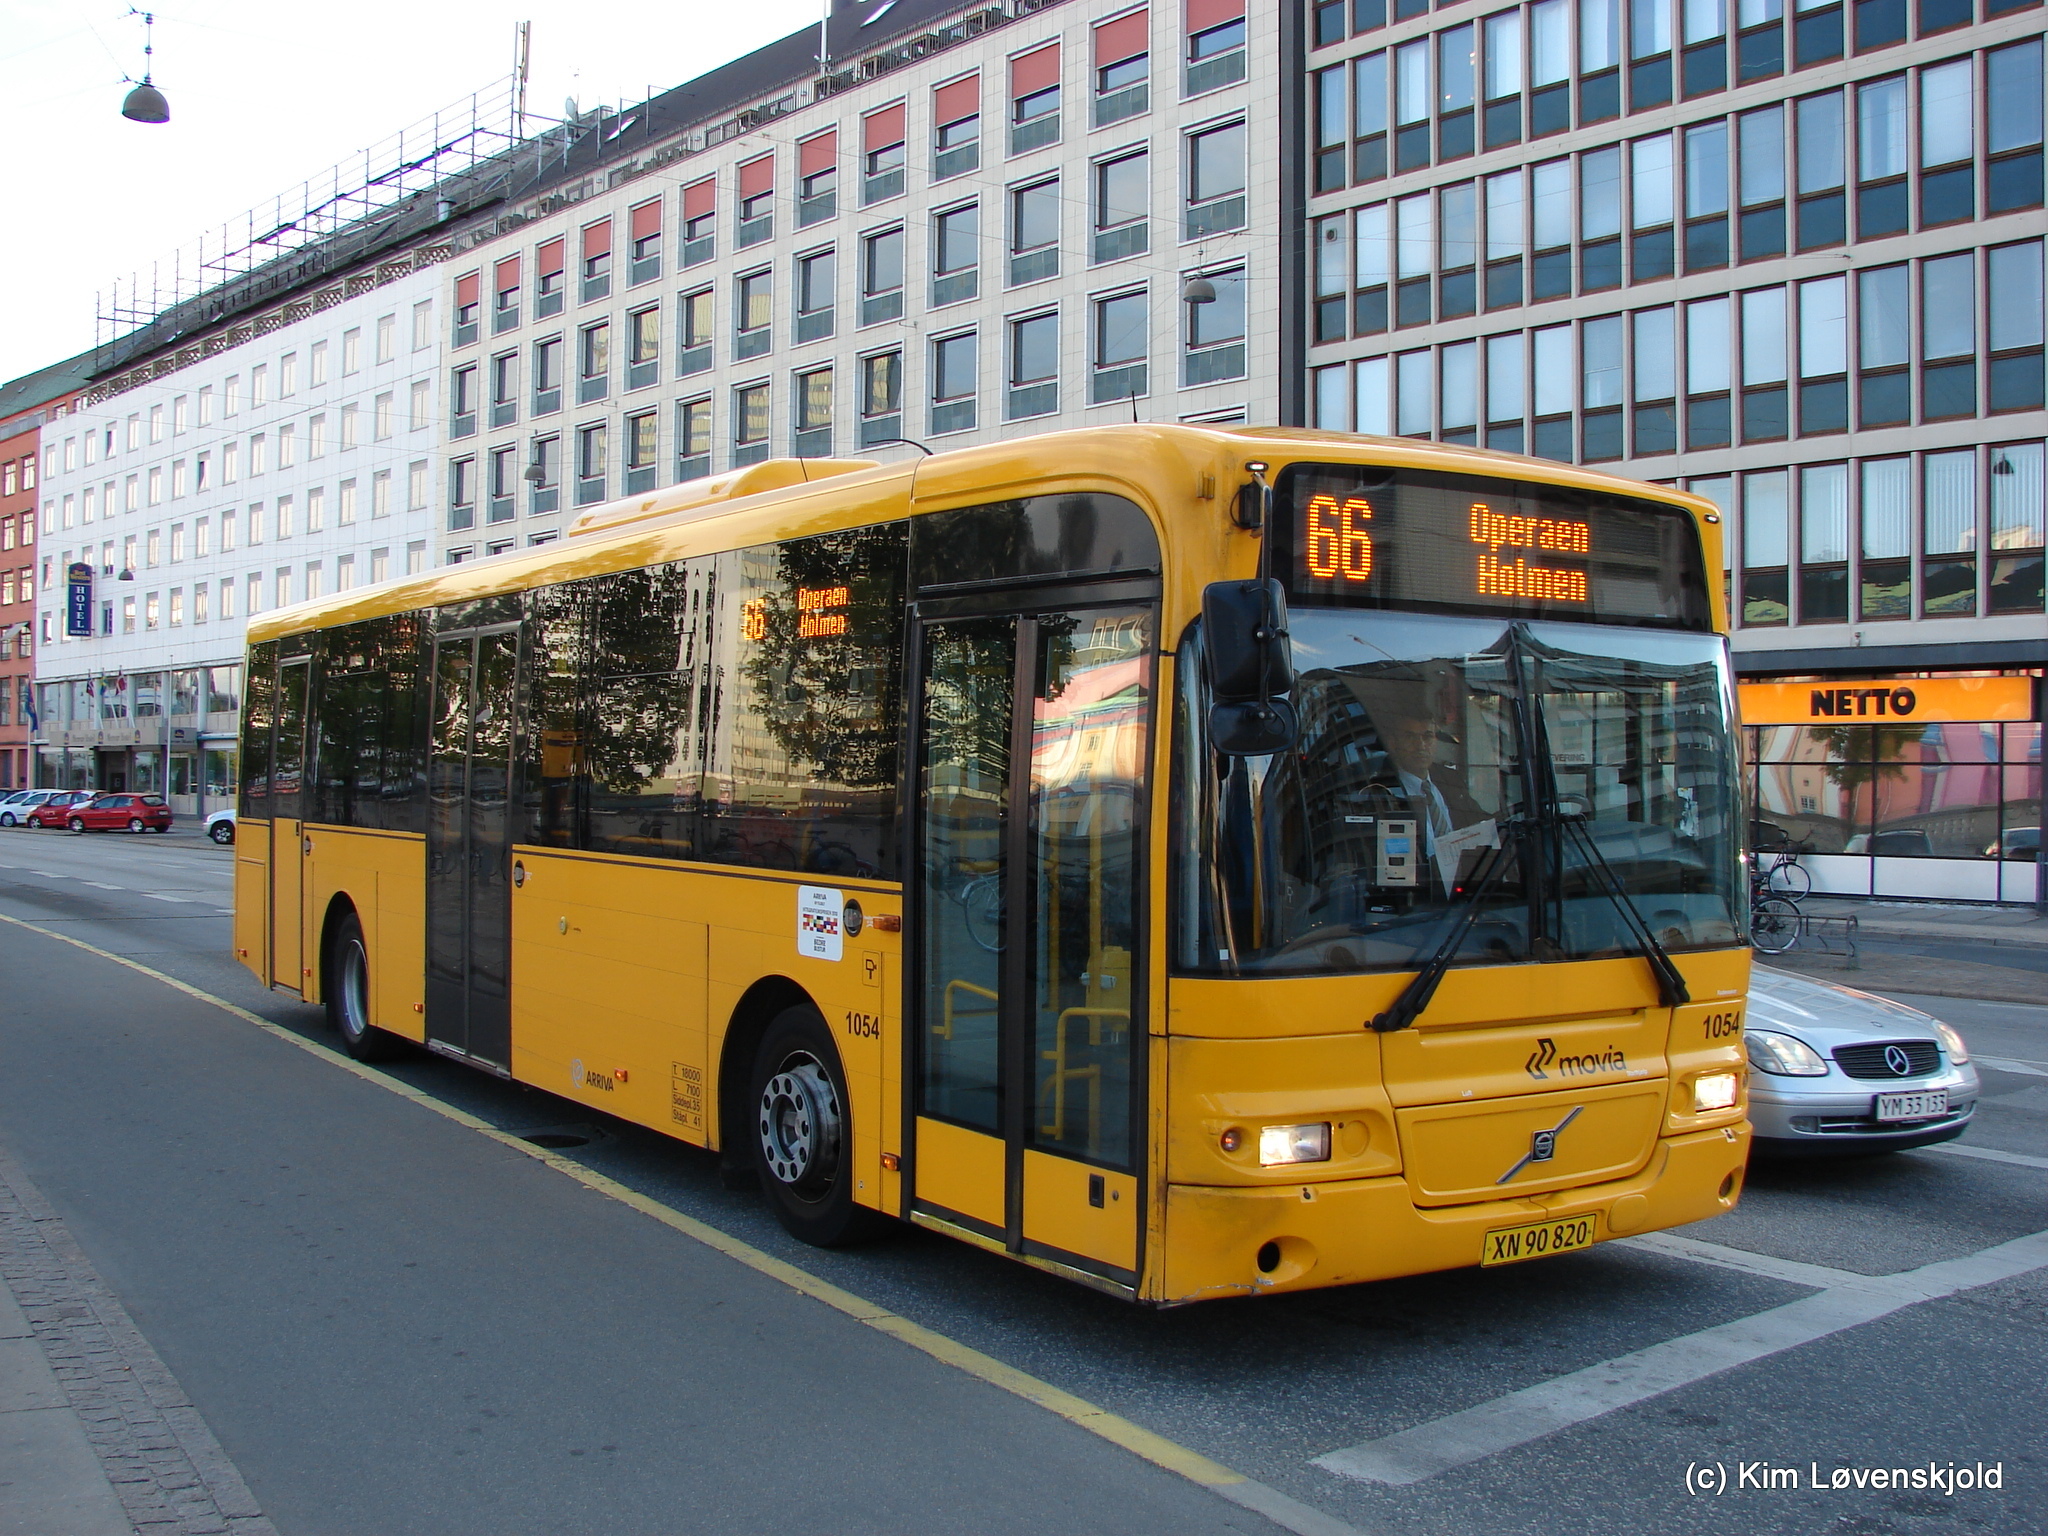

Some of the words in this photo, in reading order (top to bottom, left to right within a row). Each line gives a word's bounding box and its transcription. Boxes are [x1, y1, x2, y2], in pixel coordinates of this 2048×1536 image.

[1308, 495, 1371, 580] 66
[1470, 503, 1589, 552] Operaen
[1479, 554, 1587, 601] Holmen
[76, 586, 85, 628] HOTEL
[743, 598, 765, 640] 66
[799, 587, 847, 613] Operaen
[800, 614, 845, 637] Holmen
[1810, 687, 1916, 716] NETTO
[846, 1011, 879, 1040] 1054
[1703, 1011, 1740, 1040] 1054
[682, 1067, 700, 1082] 18000
[1559, 1045, 1626, 1077] movia
[586, 1070, 614, 1092] ARRIVA
[686, 1083, 700, 1098] 7100
[1881, 1098, 1902, 1116] YM
[1905, 1096, 1921, 1115] 33
[1926, 1094, 1945, 1113] 133
[693, 1115, 701, 1127] 41
[1492, 1233, 1521, 1260] XN
[1525, 1228, 1548, 1254] 90
[1552, 1221, 1587, 1249] 820
